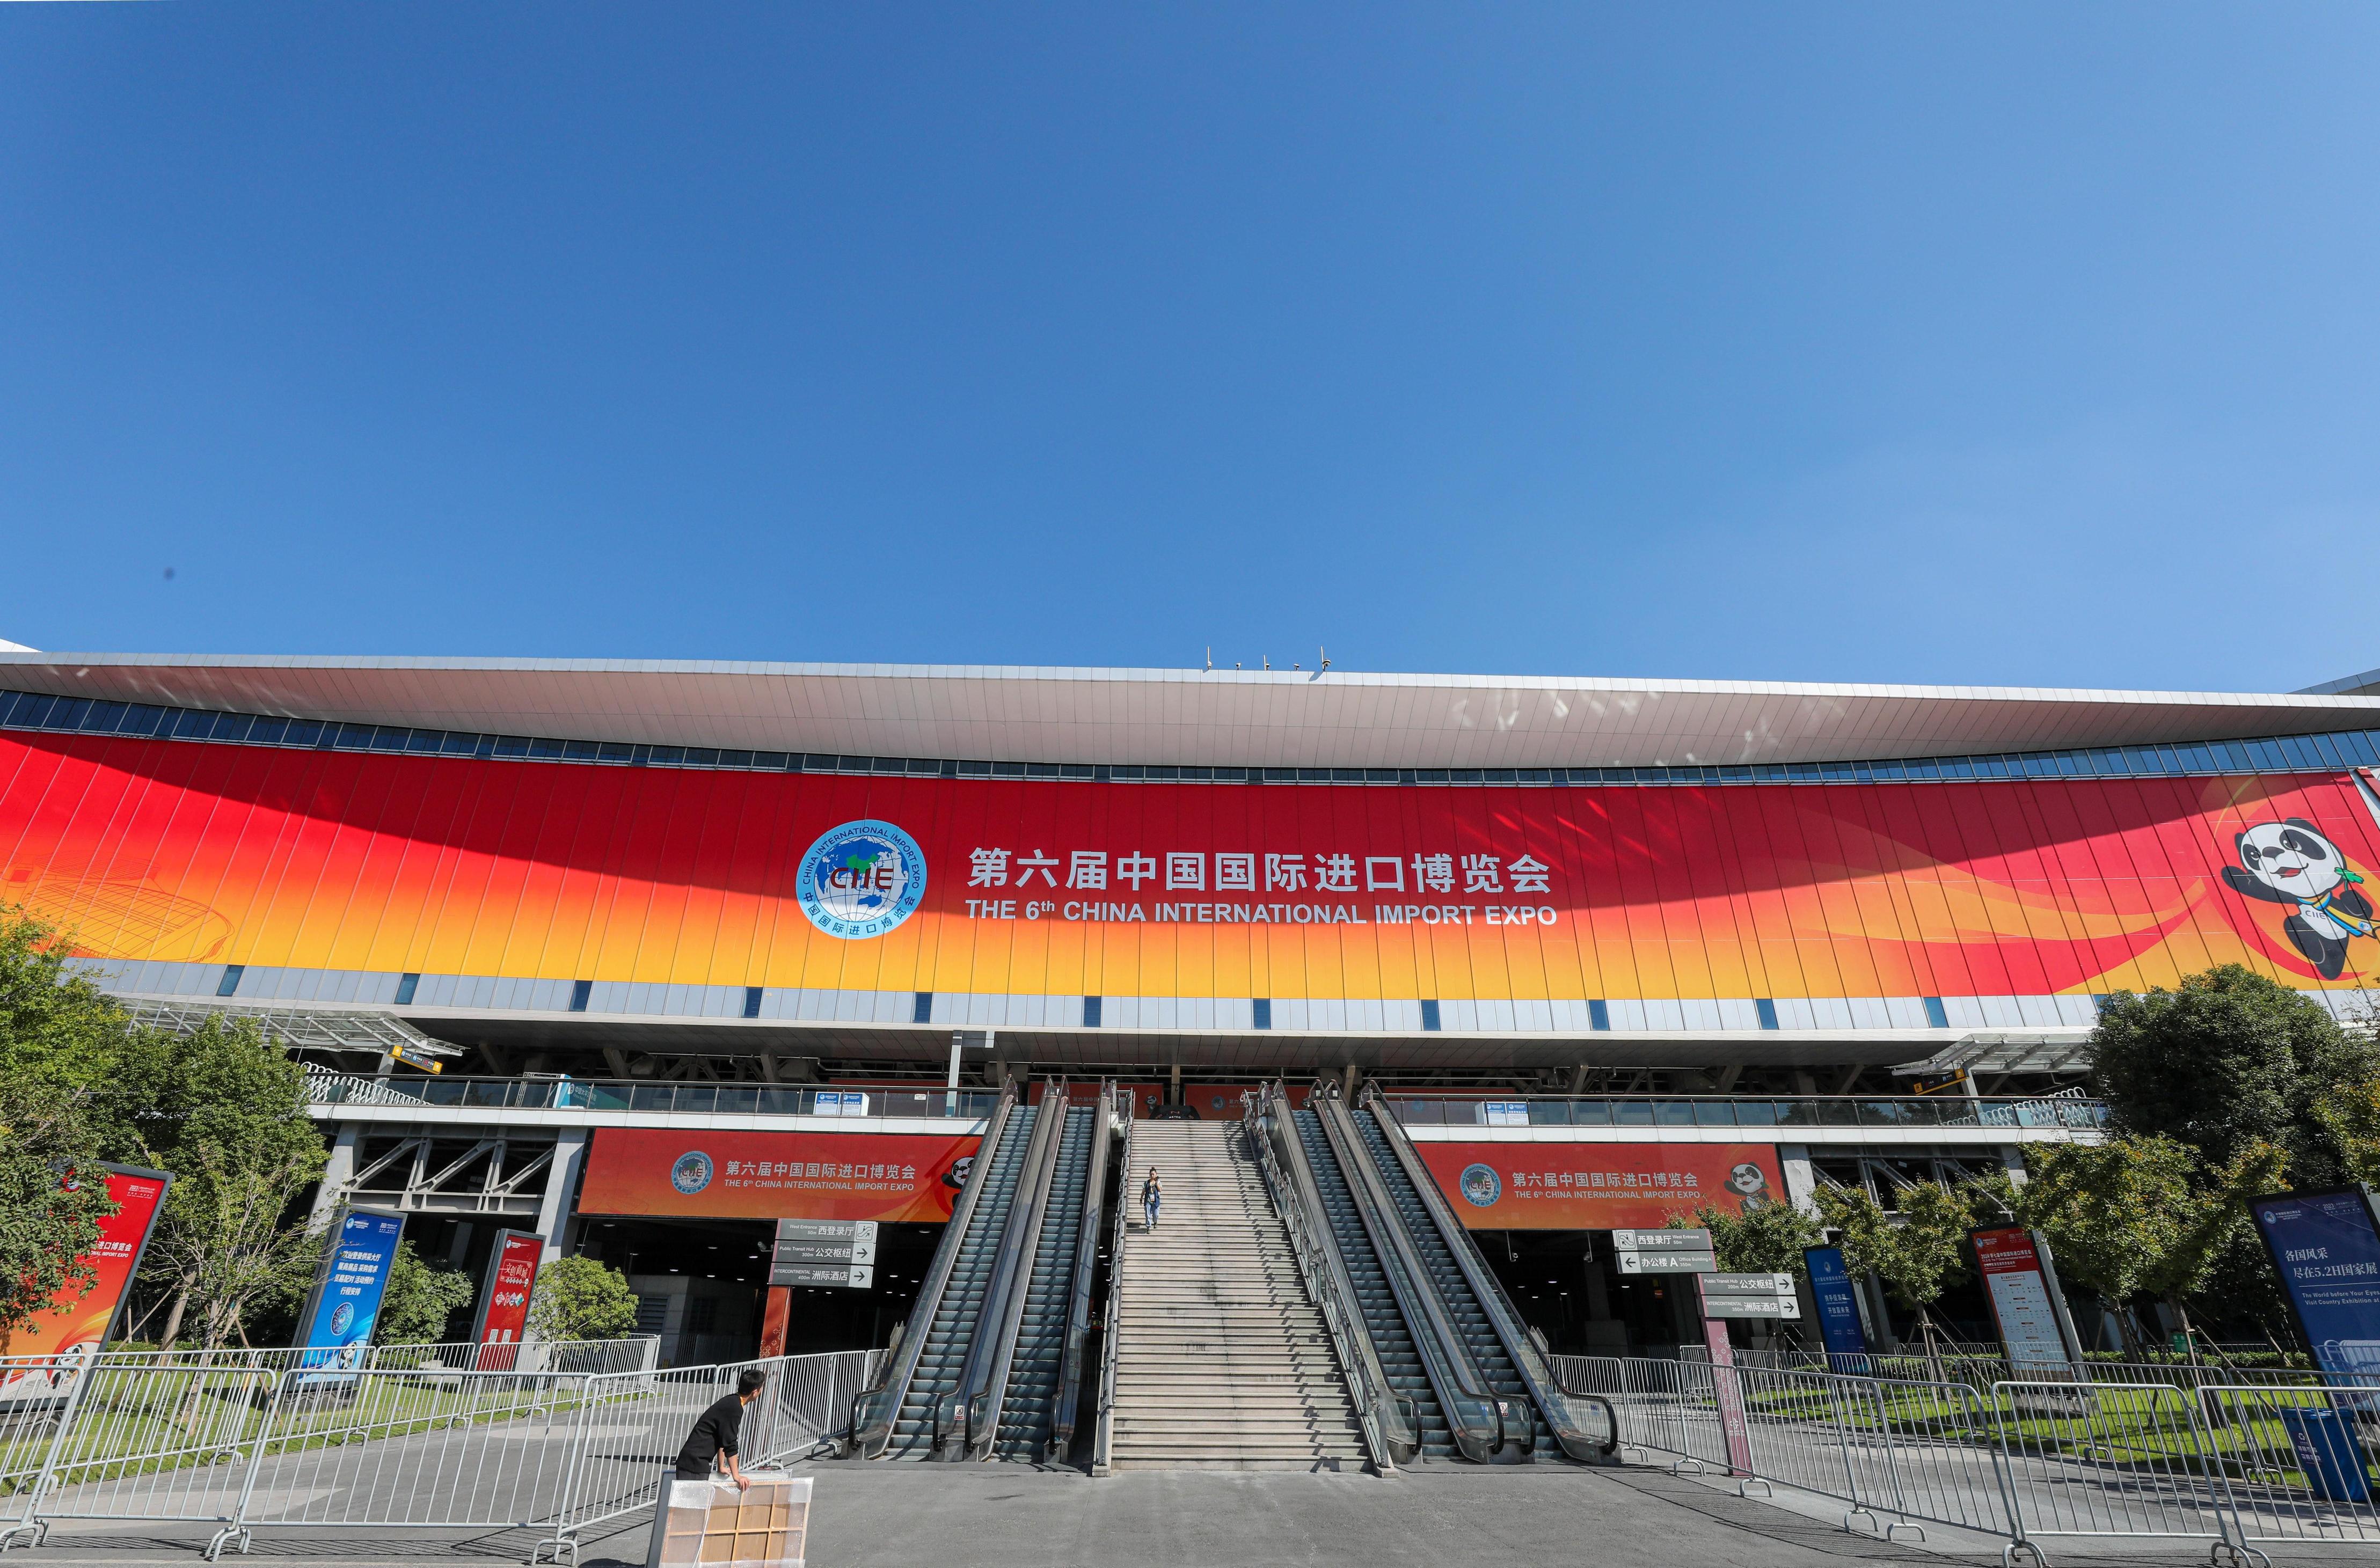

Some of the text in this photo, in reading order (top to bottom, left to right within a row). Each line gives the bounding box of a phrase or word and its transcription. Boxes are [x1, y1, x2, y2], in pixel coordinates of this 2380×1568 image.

[803, 826, 920, 889] CHINA INTERNATIONAL IMPORT EXPO
[967, 847, 1551, 893] 第六届中国国际进口博览会
[830, 867, 894, 889] CIIE
[803, 892, 915, 935] 中国国际进口博览会
[965, 899, 1557, 926] THE 6th CHINA INTERNATIONAL IMPORT EXPO
[2305, 910, 2326, 920] CIIE
[726, 1160, 916, 1179] 第六届中国国际进口博览会
[725, 1179, 740, 1187] THE
[743, 1179, 753, 1187] 6th
[784, 1181, 852, 1190] INTERNATIONAL
[890, 1183, 914, 1191] EXPO
[1513, 1173, 1698, 1188] 第六届中国国际进口博览会
[1574, 1191, 1641, 1199] INTERNATIONAL
[1643, 1191, 1675, 1199] IMPORT
[1677, 1191, 1700, 1199] EXPO
[818, 1226, 854, 1236] 西登录厅
[1638, 1235, 1671, 1245] 西登录厅
[94, 1241, 132, 1251] 进口博览会
[815, 1248, 851, 1258] 公交枢纽
[2285, 1247, 2328, 1262] 各国风采
[1641, 1257, 1678, 1267] 办公楼 A
[812, 1270, 849, 1281] 洲际酒店
[2294, 1262, 2378, 1279] 尽在5.2H国家展
[1740, 1279, 1774, 1289] 公交枢纽
[1744, 1302, 1778, 1312] 洲际酒店
